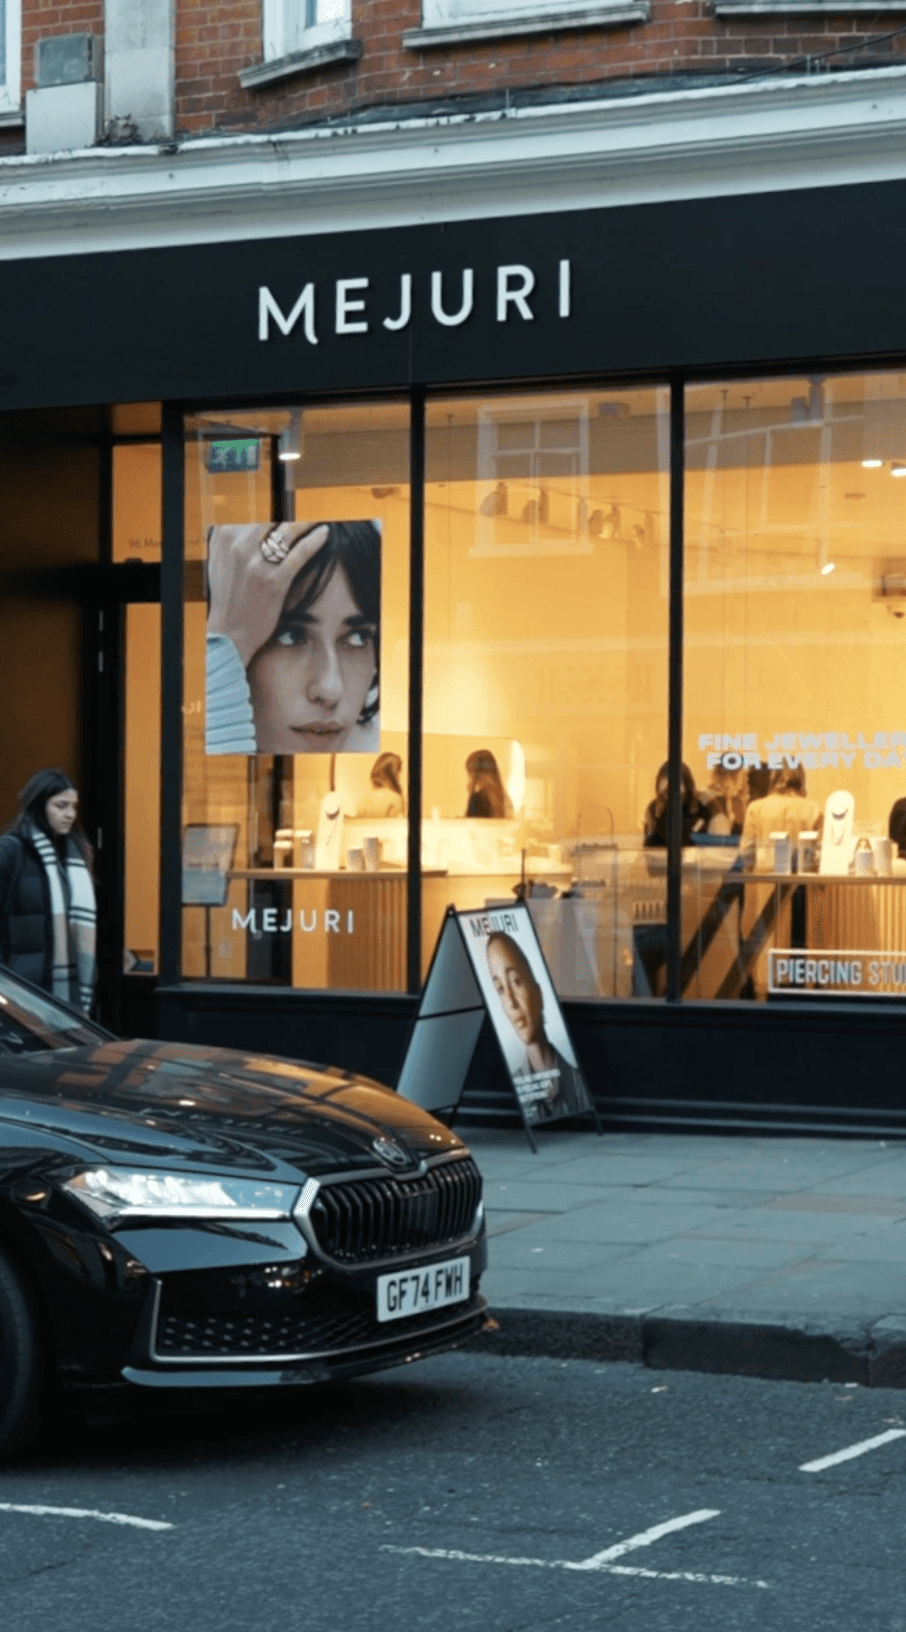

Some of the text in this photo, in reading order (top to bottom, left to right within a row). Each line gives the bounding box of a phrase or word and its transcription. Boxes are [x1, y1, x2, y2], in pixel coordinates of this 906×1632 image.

[258, 259, 571, 345] MEJURI
[698, 732, 758, 751] FINE
[706, 750, 906, 770] FOR EVERY DA
[232, 907, 354, 934] MEJURI
[468, 913, 520, 938] MEJURI
[776, 958, 906, 985] PIERCING STU
[386, 1263, 464, 1312] GF74 FWH
